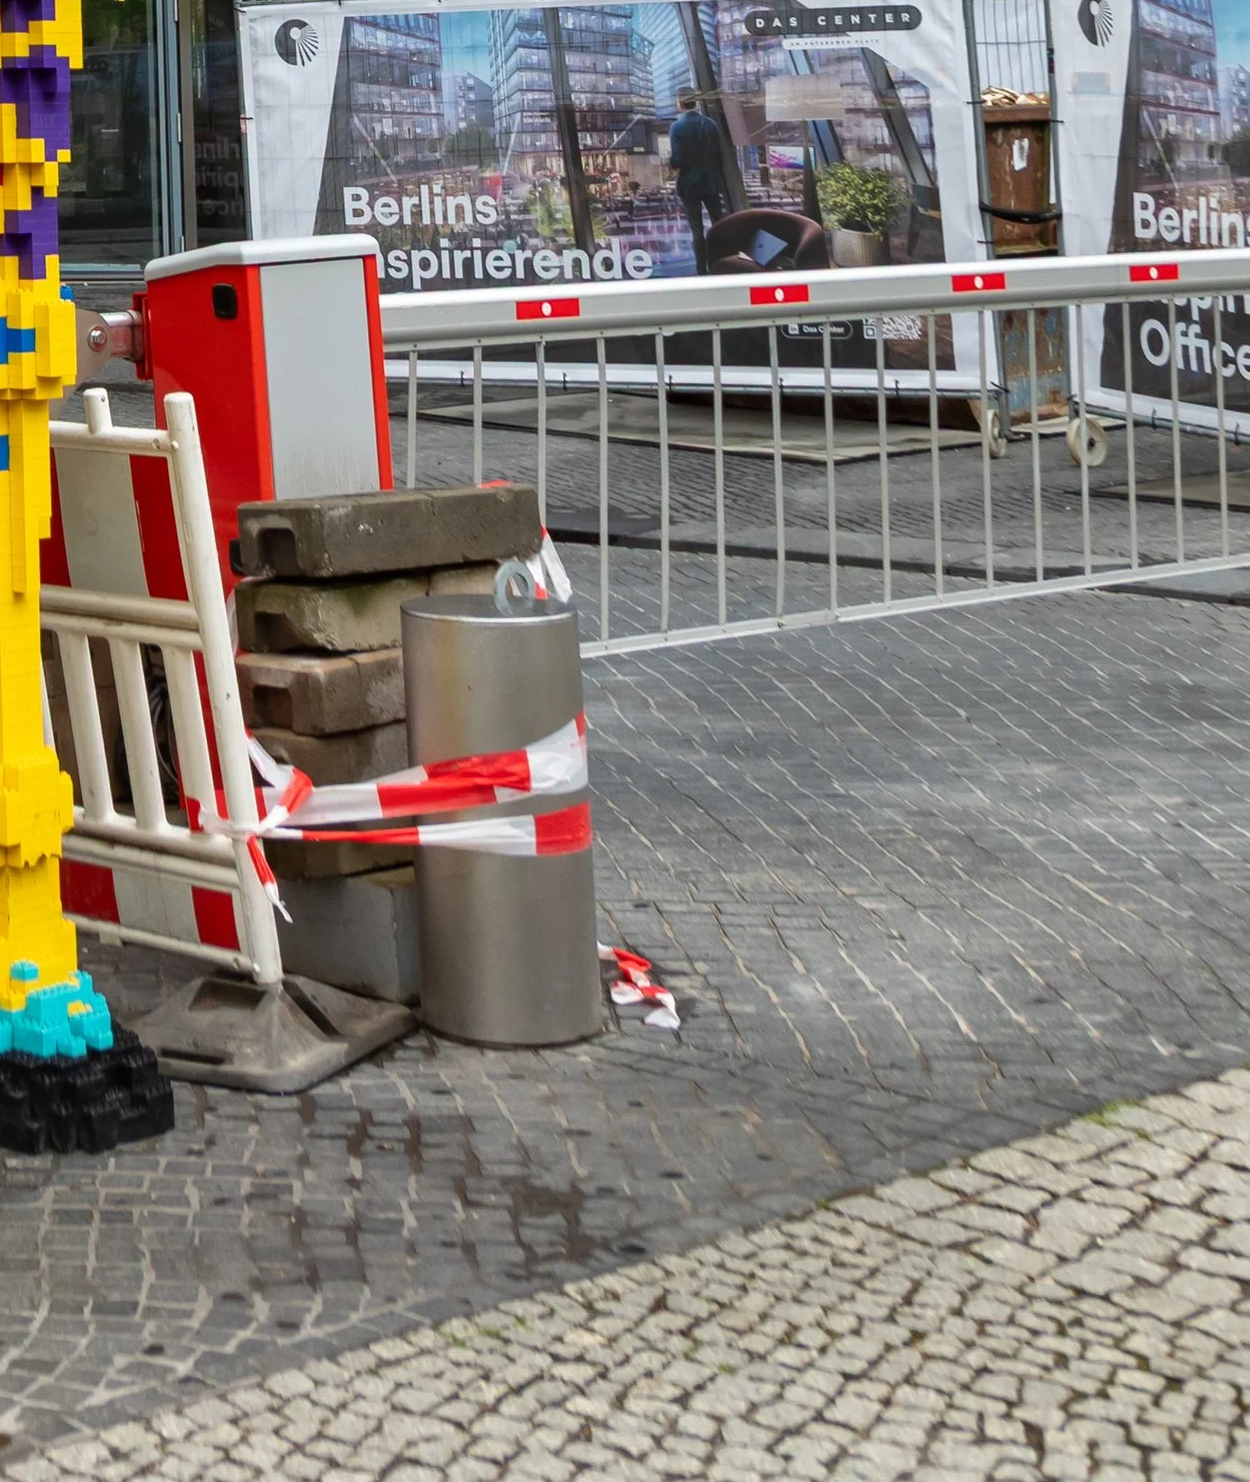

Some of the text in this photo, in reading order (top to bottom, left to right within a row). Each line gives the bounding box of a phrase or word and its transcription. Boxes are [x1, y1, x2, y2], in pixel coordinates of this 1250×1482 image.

[755, 12, 911, 29] DAS CENTER
[343, 184, 498, 226] Berlins
[1133, 191, 1250, 248] Berlin
[377, 237, 653, 290] spirierende
[818, 325, 845, 334] Cnter
